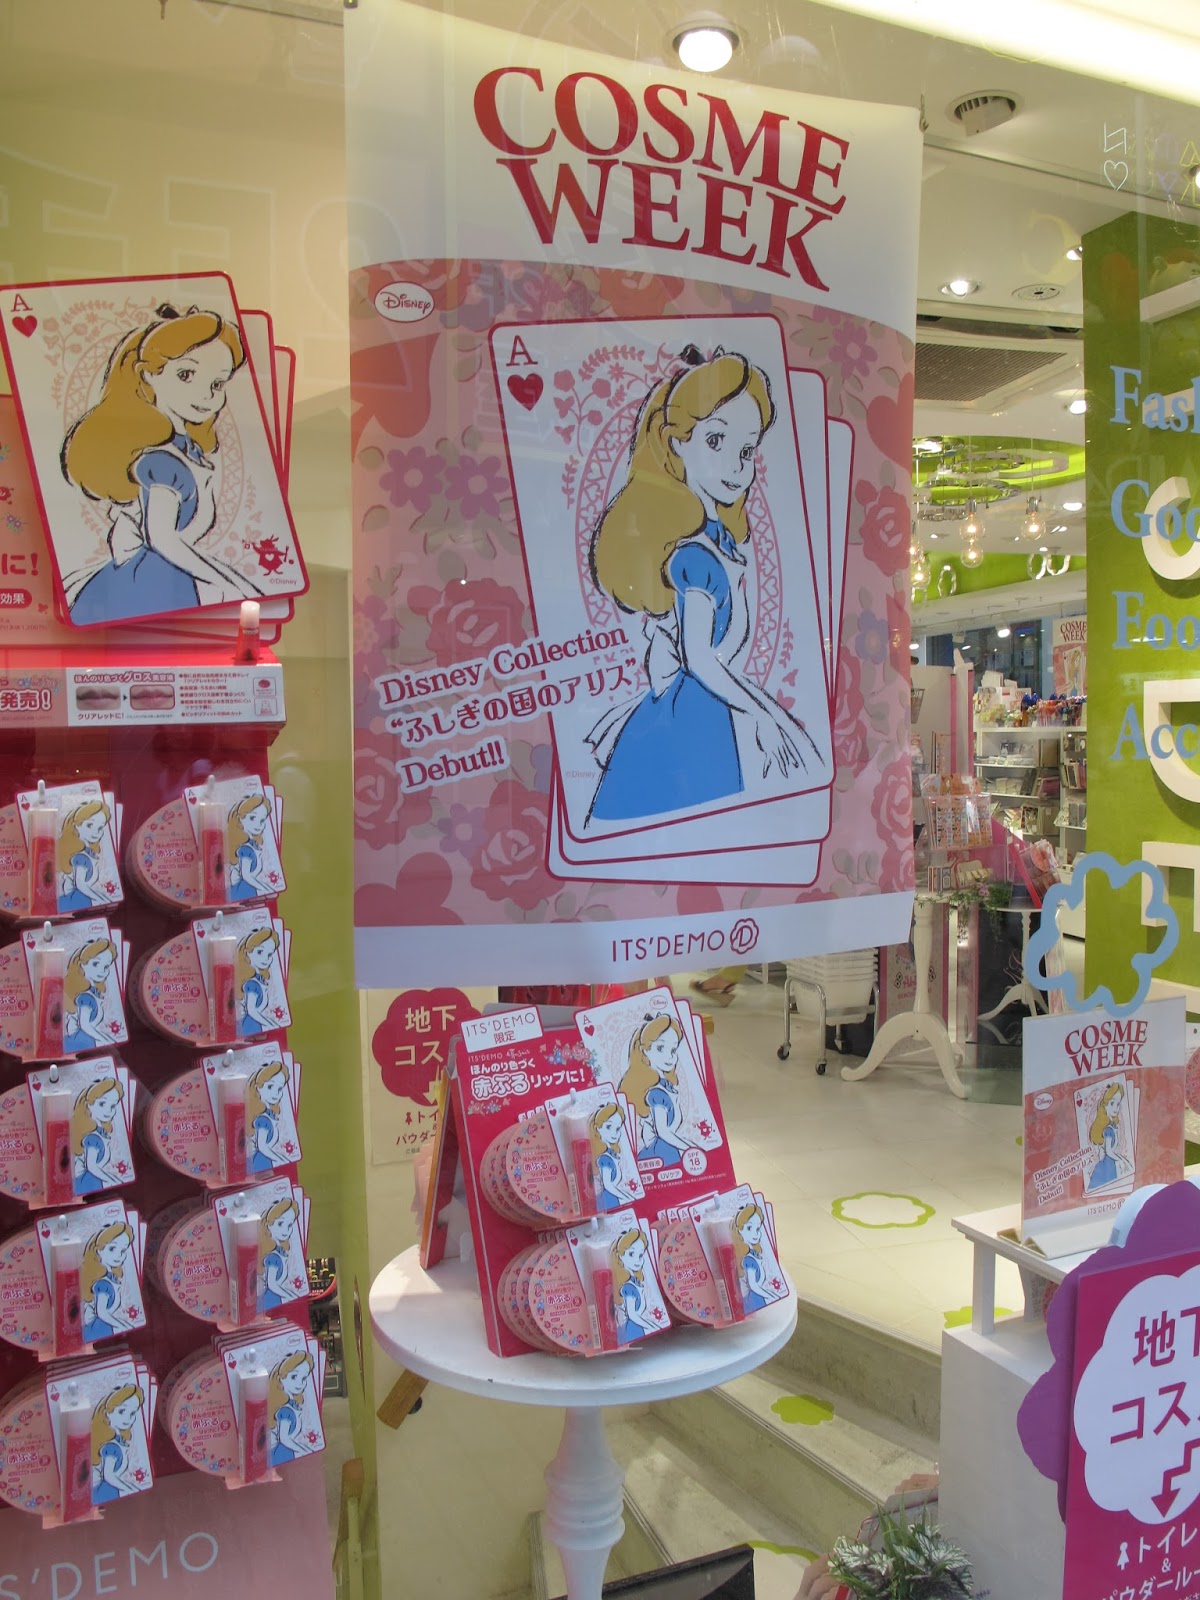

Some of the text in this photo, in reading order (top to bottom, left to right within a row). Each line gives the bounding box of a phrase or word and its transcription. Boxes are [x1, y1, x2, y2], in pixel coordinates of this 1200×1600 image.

[474, 67, 849, 214] COSME
[496, 157, 832, 292] WEEK
[10, 294, 33, 312] A
[381, 292, 432, 316] Disney
[506, 335, 538, 367] A
[1110, 365, 1200, 433] Fas
[1062, 630, 1086, 642] WEEK
[380, 628, 629, 705] Disney Collection
[401, 741, 505, 788] Debut!!
[612, 930, 725, 962] ITS'DEMO
[405, 1004, 457, 1034] 地下
[466, 1012, 536, 1037] ITS'DEMO
[494, 1030, 516, 1044] 限定
[1065, 1020, 1148, 1057] COSME
[395, 1041, 444, 1066] コス
[470, 1058, 536, 1075] ほんのり色づく
[1069, 1043, 1144, 1076] WEEK
[690, 1158, 701, 1166] 18
[1034, 1146, 1092, 1181] Disney Collection
[1110, 1381, 1200, 1445] コス
[1139, 1522, 1198, 1563] トイレ
[1162, 1558, 1171, 1573] &
